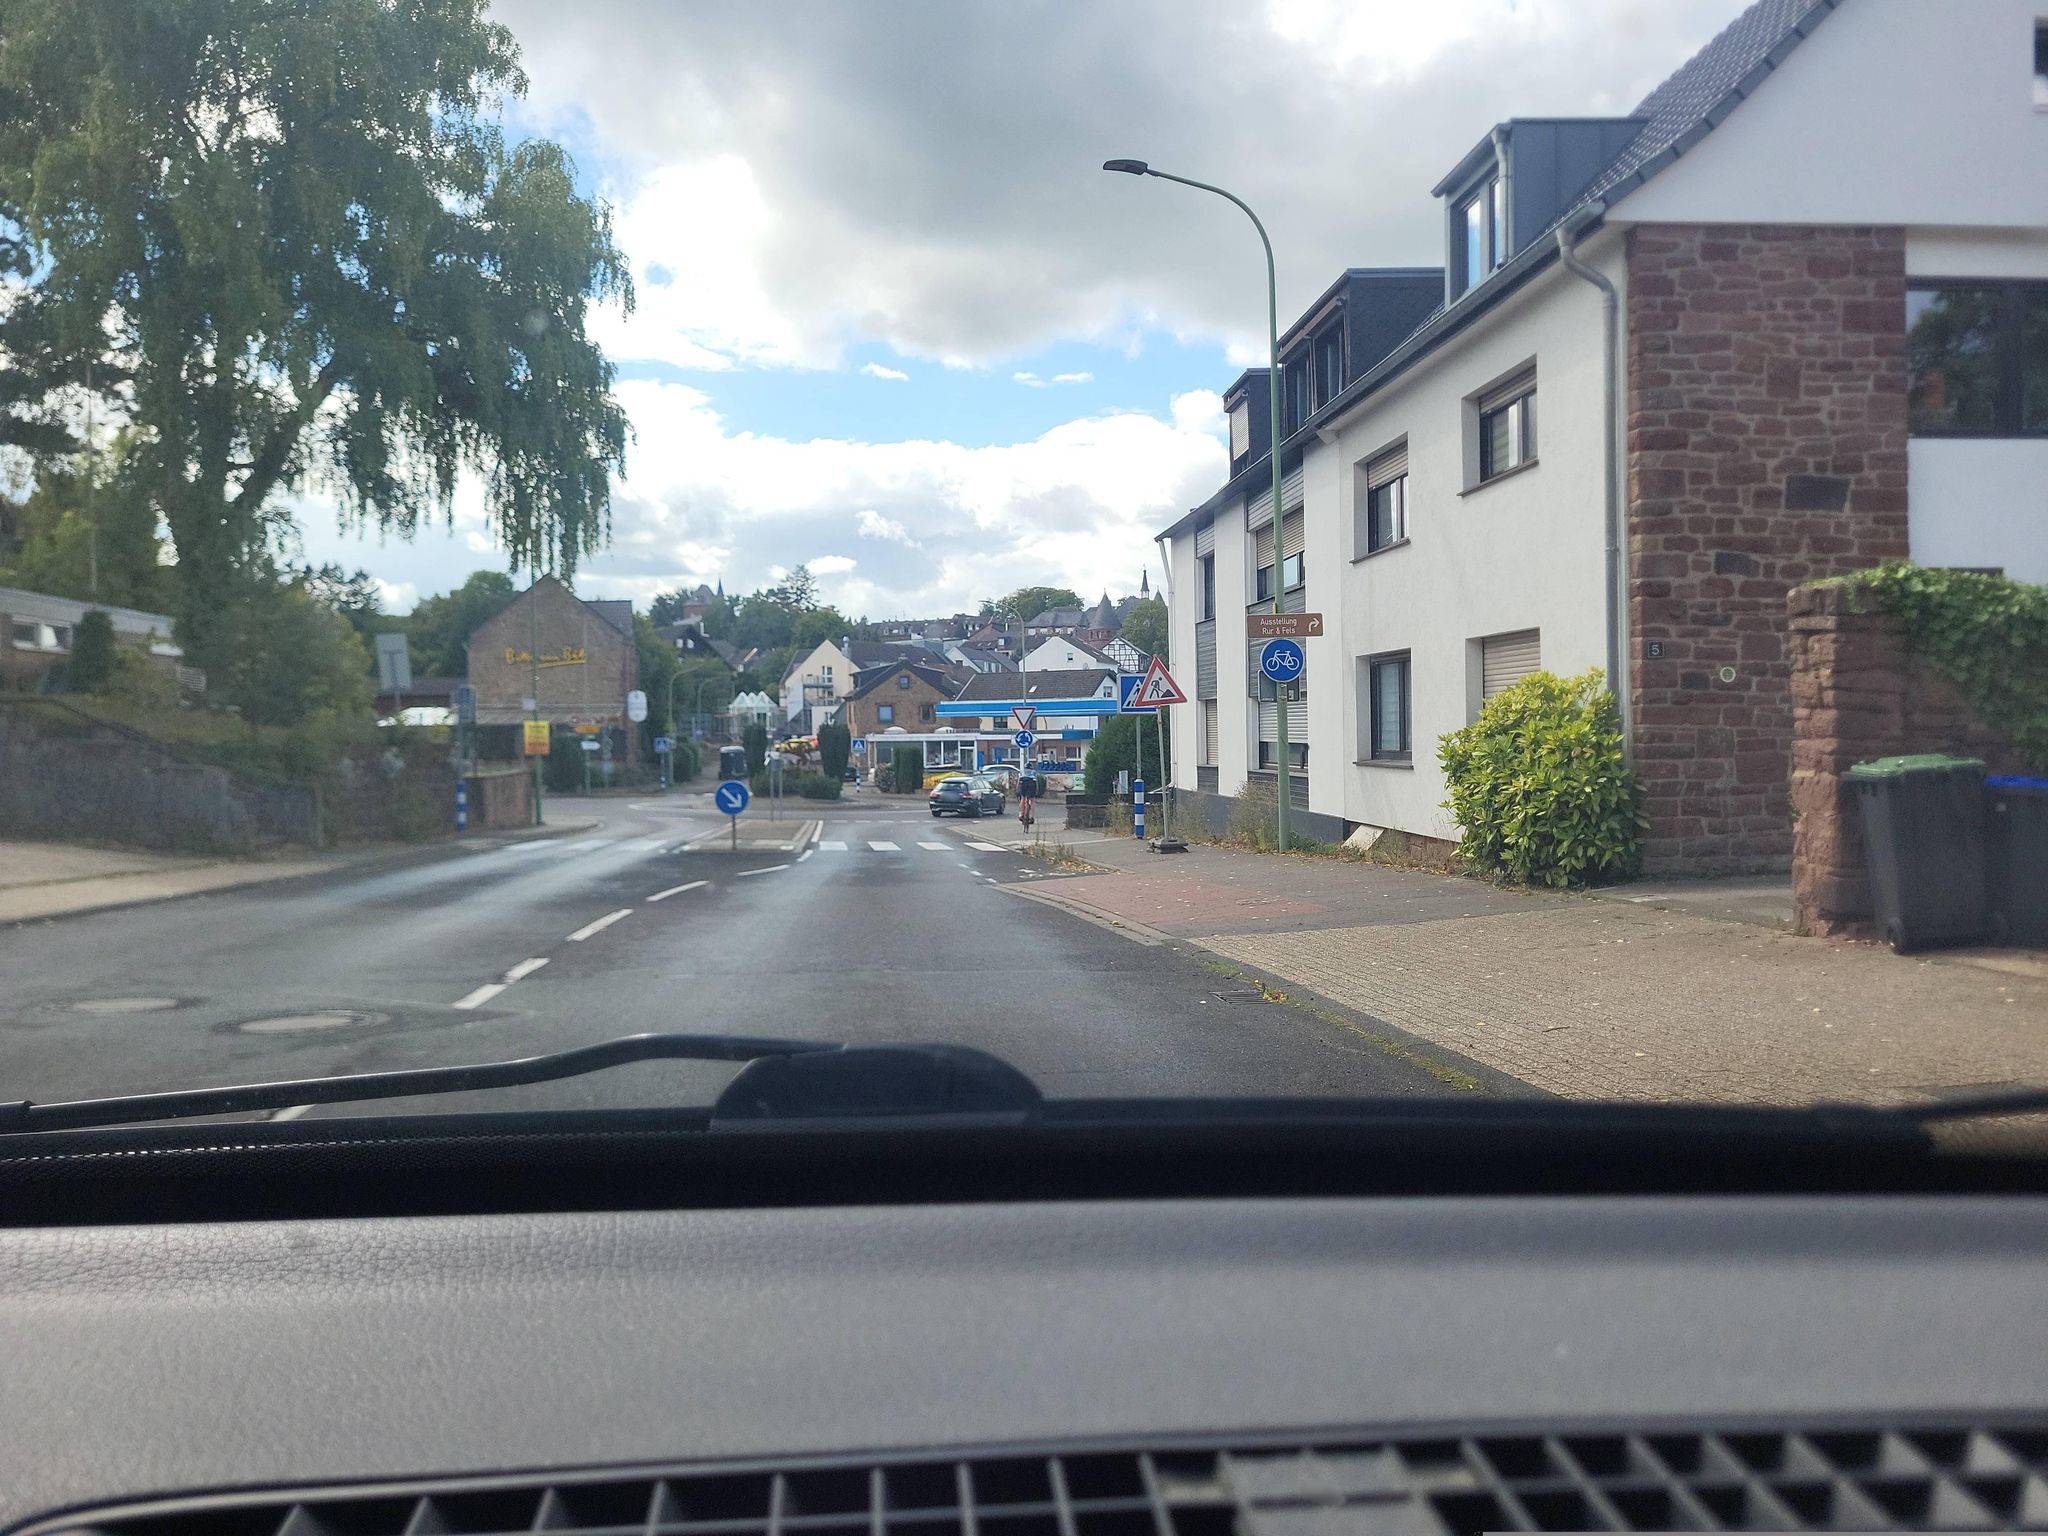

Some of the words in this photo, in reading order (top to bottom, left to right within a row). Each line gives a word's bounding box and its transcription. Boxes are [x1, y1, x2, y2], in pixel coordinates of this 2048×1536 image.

[1260, 617, 1297, 626] Ausstellung
[1262, 627, 1274, 635] Rur
[1276, 627, 1281, 635] &
[1651, 644, 1660, 655] 5
